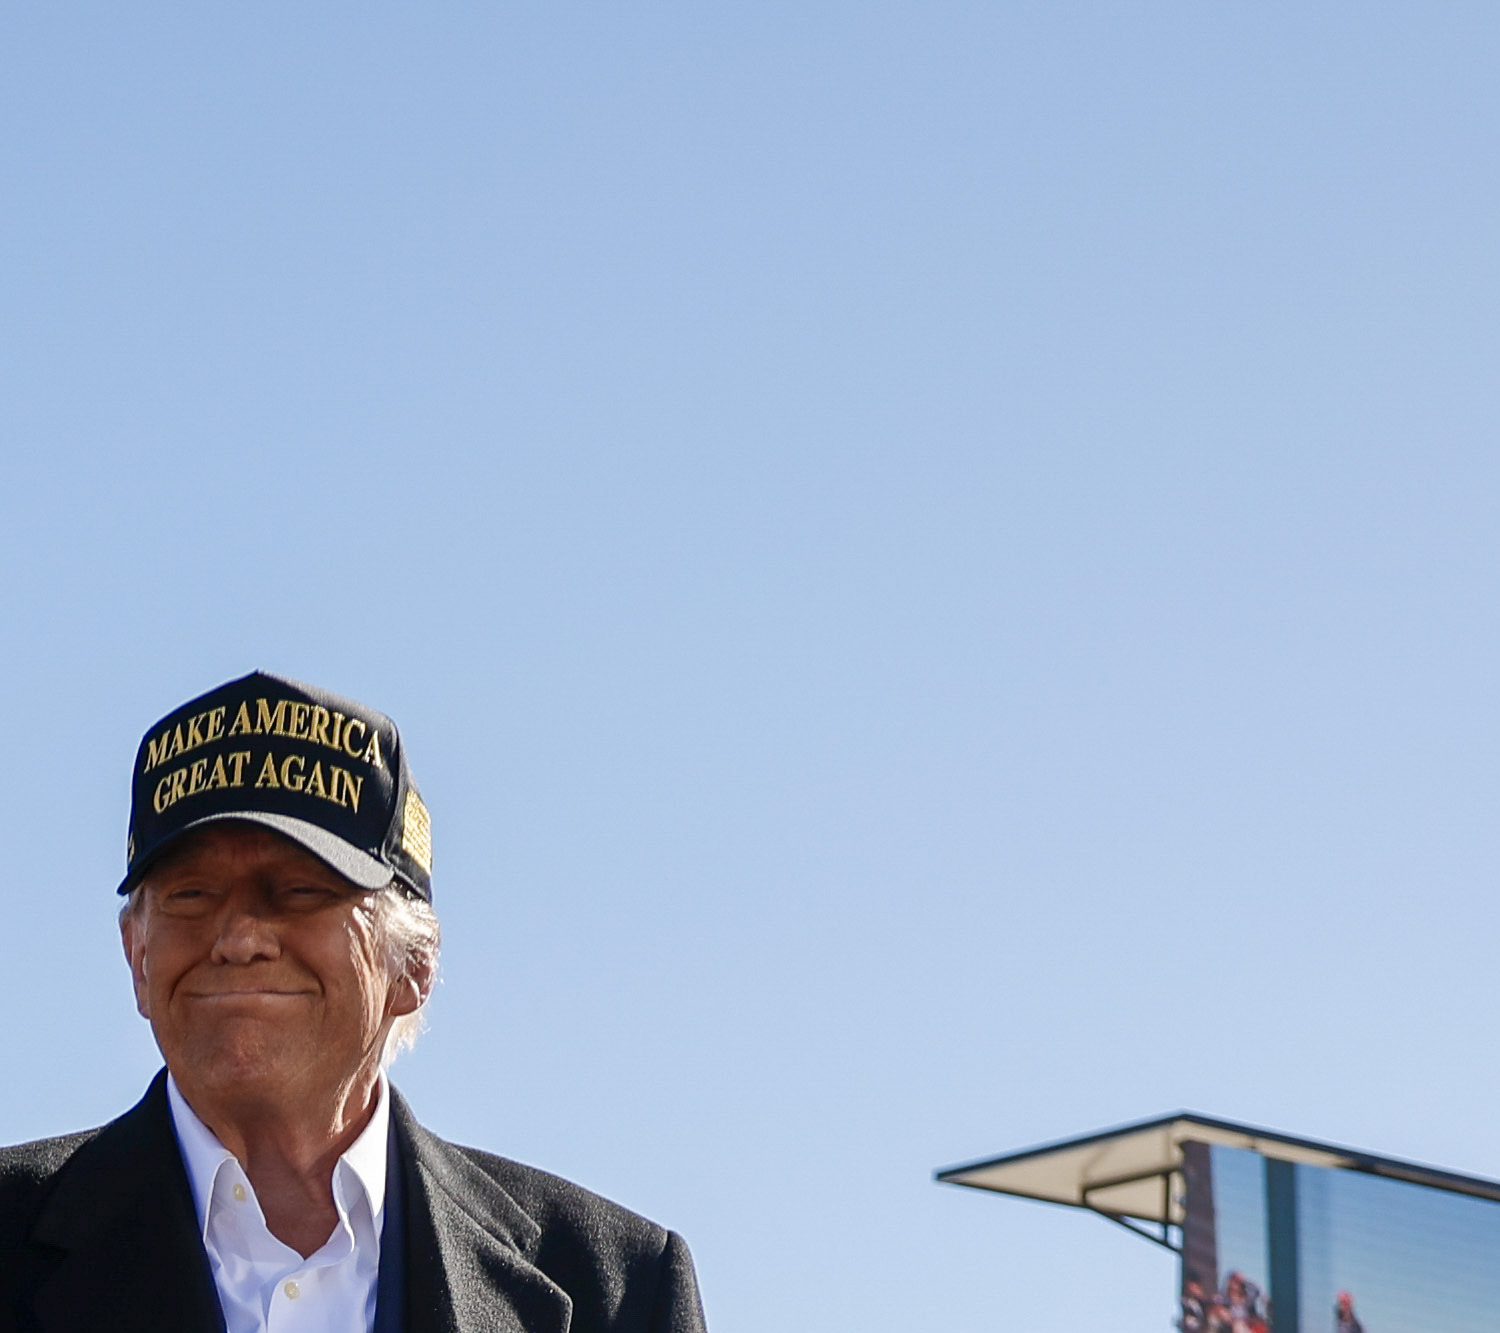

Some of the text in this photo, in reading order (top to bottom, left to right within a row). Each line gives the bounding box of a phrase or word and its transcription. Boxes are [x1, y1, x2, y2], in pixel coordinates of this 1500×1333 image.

[143, 697, 384, 774] MAKE AMERICA
[153, 751, 364, 815] GREAT AGAIN
